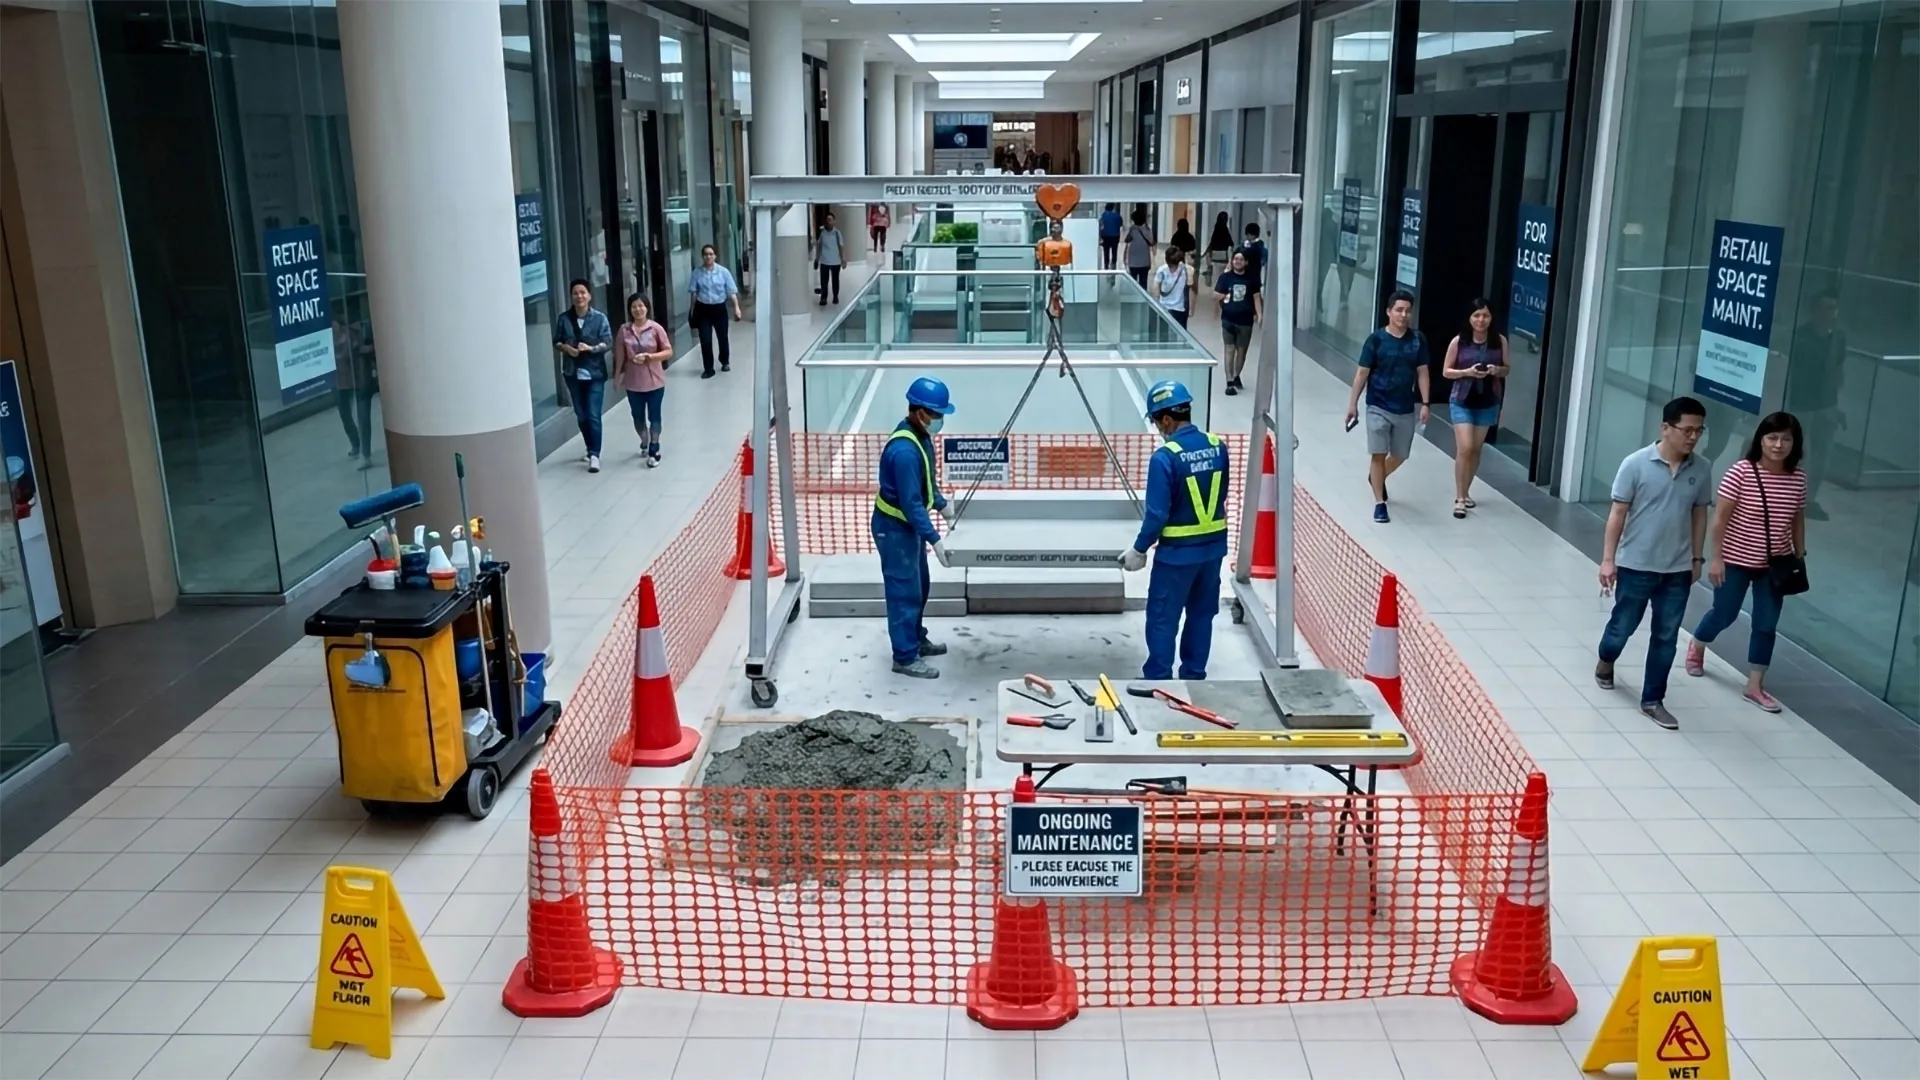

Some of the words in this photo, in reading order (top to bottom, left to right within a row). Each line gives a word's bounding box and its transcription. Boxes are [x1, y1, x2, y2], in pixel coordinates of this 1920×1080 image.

[1524, 219, 1547, 244] FOR
[271, 239, 318, 267] RETAIL
[1516, 247, 1551, 274] LEASE
[1719, 235, 1771, 266] RETAIL
[276, 268, 319, 297] SPACE
[1716, 267, 1768, 298] SPACE
[279, 297, 324, 327] MAINT.
[1711, 297, 1763, 330] MAINT.
[1038, 813, 1112, 830] ONGOING
[1017, 834, 1133, 851] MAINTENANCE
[1022, 860, 1063, 872] PLEASE
[1111, 860, 1133, 872] THE
[1030, 875, 1119, 887] INCONVENIENCE
[1653, 990, 1712, 1004] CAUTION
[1668, 1066, 1700, 1079] WET
